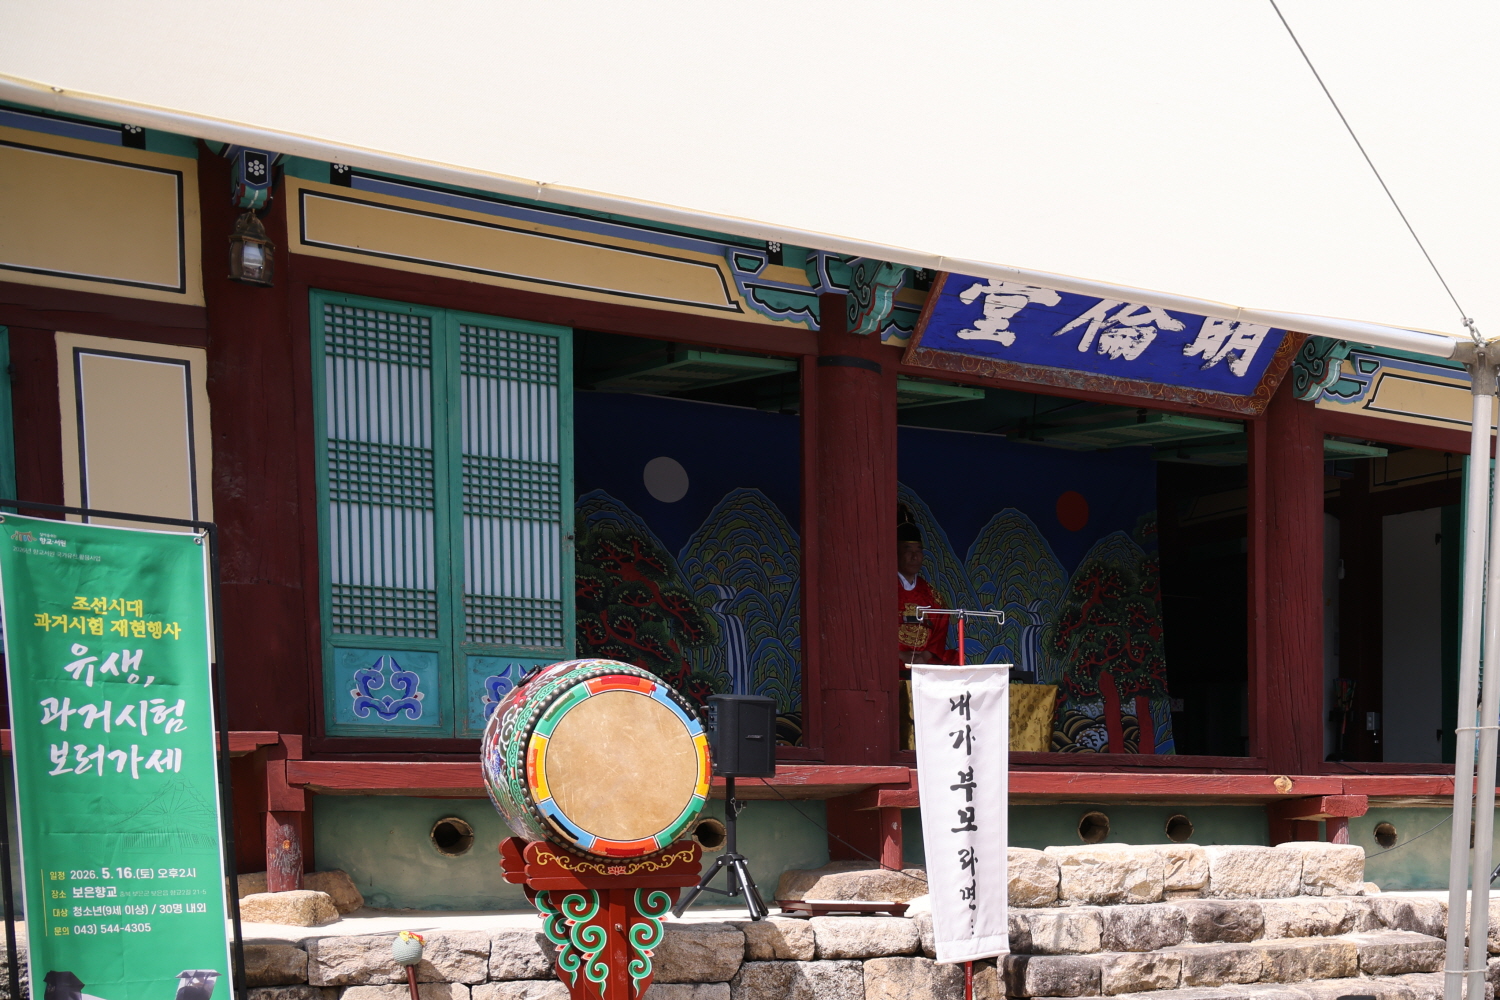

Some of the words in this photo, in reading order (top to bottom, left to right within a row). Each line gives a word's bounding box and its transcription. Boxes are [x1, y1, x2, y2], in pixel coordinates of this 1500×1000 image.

[72, 596, 143, 618] 조선시대
[34, 613, 104, 636] 과거시험
[110, 619, 181, 640] 재현행사
[64, 643, 155, 688] 유생,
[40, 697, 187, 736] 과거시험
[48, 741, 182, 779] 보러가세
[49, 871, 66, 881] 일정
[70, 869, 99, 880] 2026.
[101, 867, 114, 879] 5.
[157, 867, 197, 878] 오후2시
[51, 889, 67, 899] 장소
[72, 886, 118, 899] 보은향교
[52, 908, 68, 917] 대상
[72, 904, 122, 917] 청소년(9세
[124, 903, 149, 916] 이상)
[159, 903, 183, 914] 30명
[186, 902, 207, 913] 내외
[54, 926, 70, 936] 문의
[73, 923, 97, 935] 043)
[100, 922, 152, 934] 544-4305
